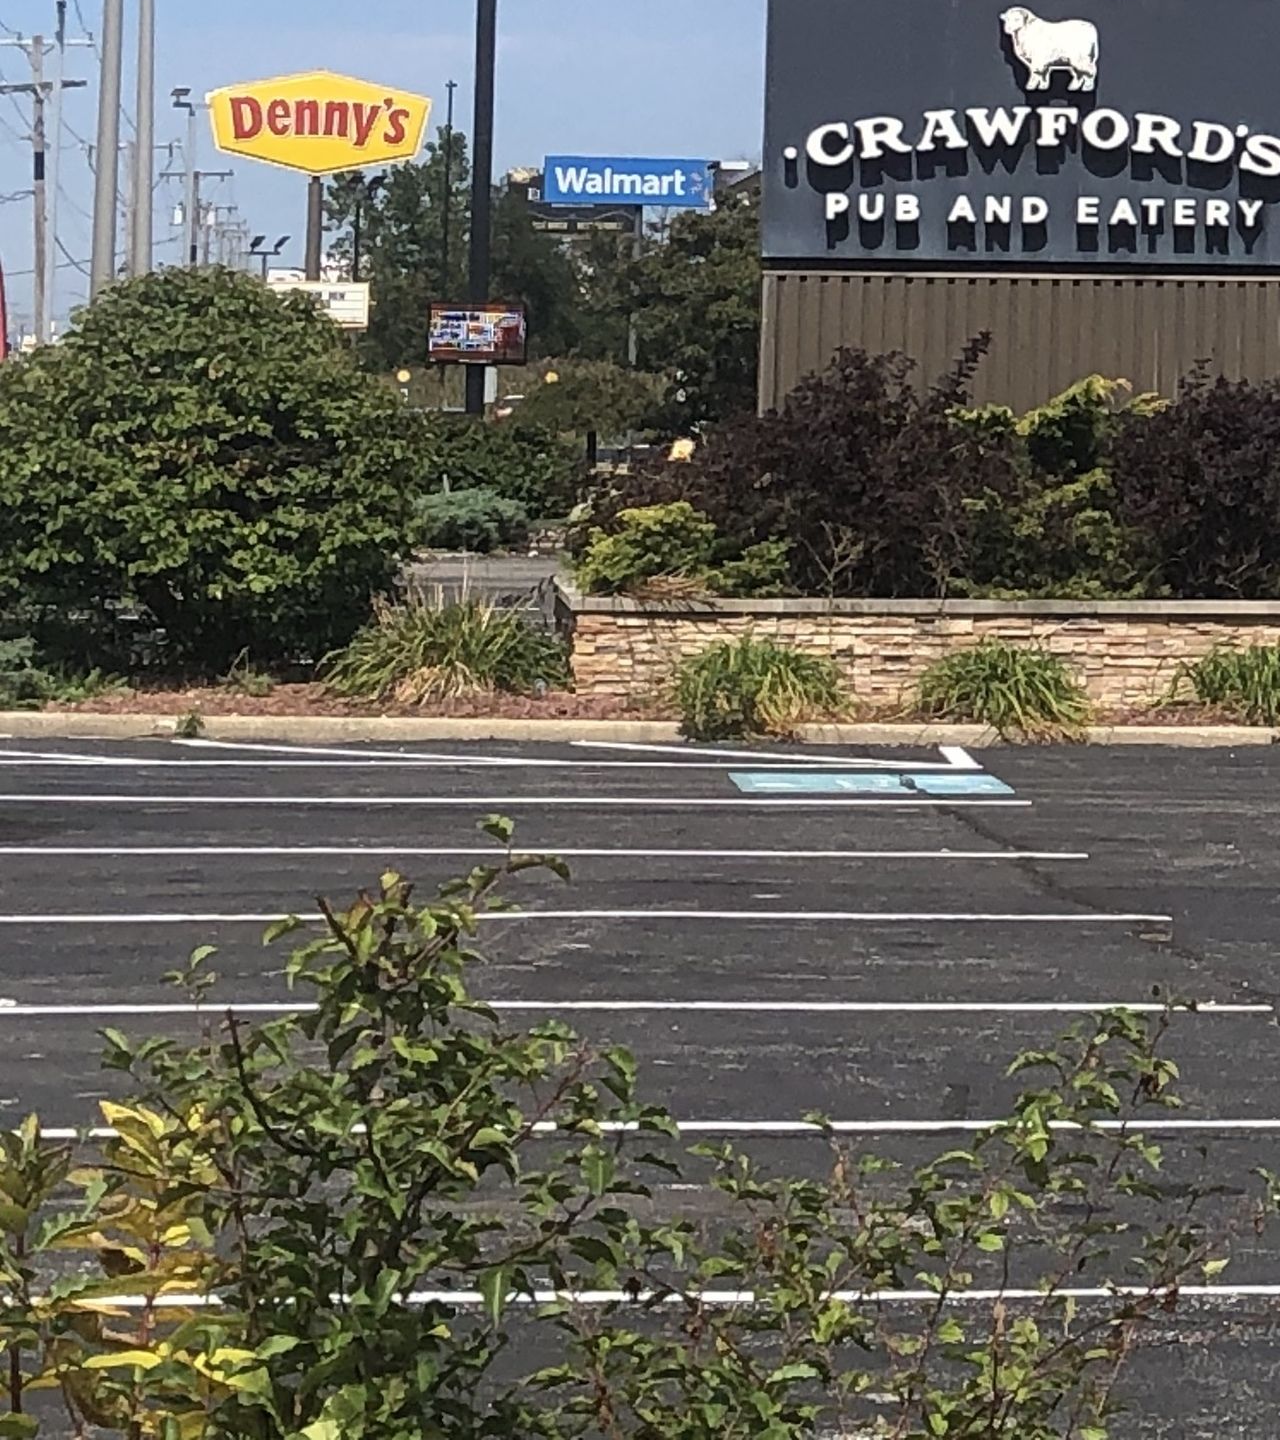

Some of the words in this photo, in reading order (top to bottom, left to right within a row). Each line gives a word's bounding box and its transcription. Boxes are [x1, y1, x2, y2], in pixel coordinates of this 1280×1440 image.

[229, 95, 410, 147] Denny's
[554, 166, 687, 197] Walmart
[825, 192, 921, 221] PUB
[947, 194, 1050, 224] AND
[1076, 196, 1263, 227] EATERY
